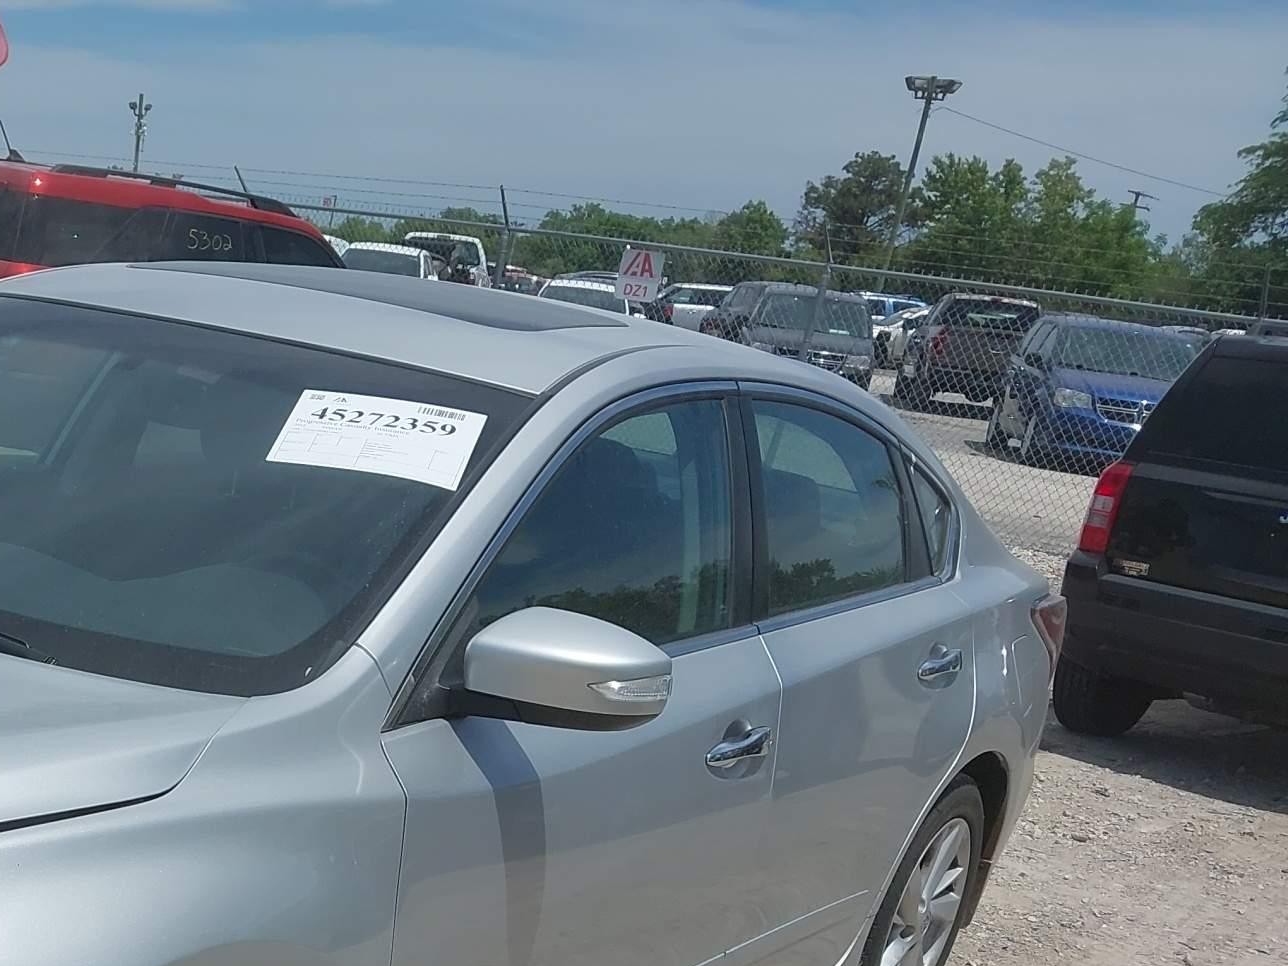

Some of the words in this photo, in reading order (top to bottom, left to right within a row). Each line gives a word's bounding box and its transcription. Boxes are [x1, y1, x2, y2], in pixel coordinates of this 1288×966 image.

[187, 228, 233, 251] 5302
[623, 283, 648, 297] DZ1
[311, 406, 457, 437] 45272359
